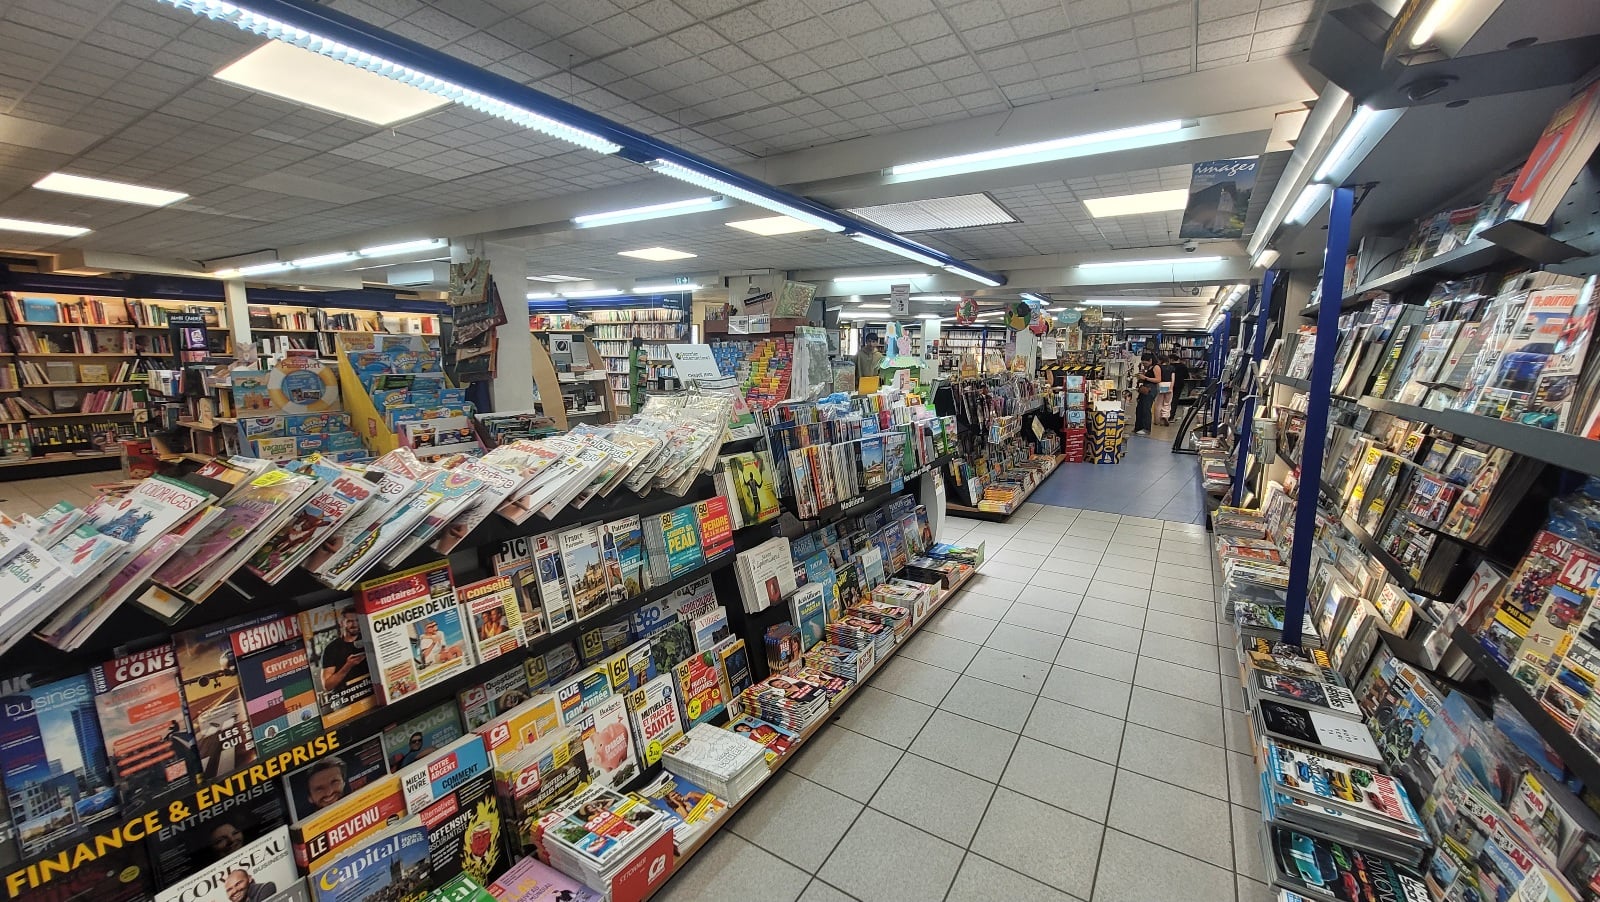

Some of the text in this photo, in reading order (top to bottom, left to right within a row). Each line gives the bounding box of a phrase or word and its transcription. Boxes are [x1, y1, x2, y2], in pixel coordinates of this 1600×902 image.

[1195, 161, 1256, 177] images
[703, 515, 729, 532] PERDRE
[668, 531, 696, 554] PEAU
[380, 589, 417, 605] notaires
[466, 577, 511, 598] conseils
[373, 594, 457, 633] CHANGER DE VIE
[238, 619, 287, 653] GESTION
[584, 630, 600, 648] 60
[114, 645, 171, 668] INVESTIS
[115, 651, 175, 682] CONS
[613, 658, 627, 676] 60
[680, 664, 689, 675] 60
[5, 684, 88, 717] busines
[560, 681, 579, 700] QUE
[634, 690, 645, 703] 60
[565, 690, 608, 720] randonnée
[641, 697, 672, 718] MUTUELLES
[650, 708, 666, 724] FRAIS
[218, 728, 239, 742] LES
[222, 738, 242, 750] QUI
[429, 757, 449, 772] VOTRE
[431, 761, 456, 781] ARGENT
[405, 770, 427, 787] MIEUX
[406, 778, 427, 793] VIVRE
[442, 763, 478, 789] COMMENT
[158, 780, 275, 842] ENTREPRISE
[421, 798, 455, 818] Alternatives
[555, 788, 594, 813] Questions
[1526, 791, 1544, 812] AUTO
[5, 730, 341, 899] FINANCE & ENTREPRISE
[309, 806, 380, 858] LE REVENU
[428, 809, 473, 843] 'OFFENSIVE
[252, 851, 289, 875] BUSINESS
[320, 835, 401, 891] Capital
